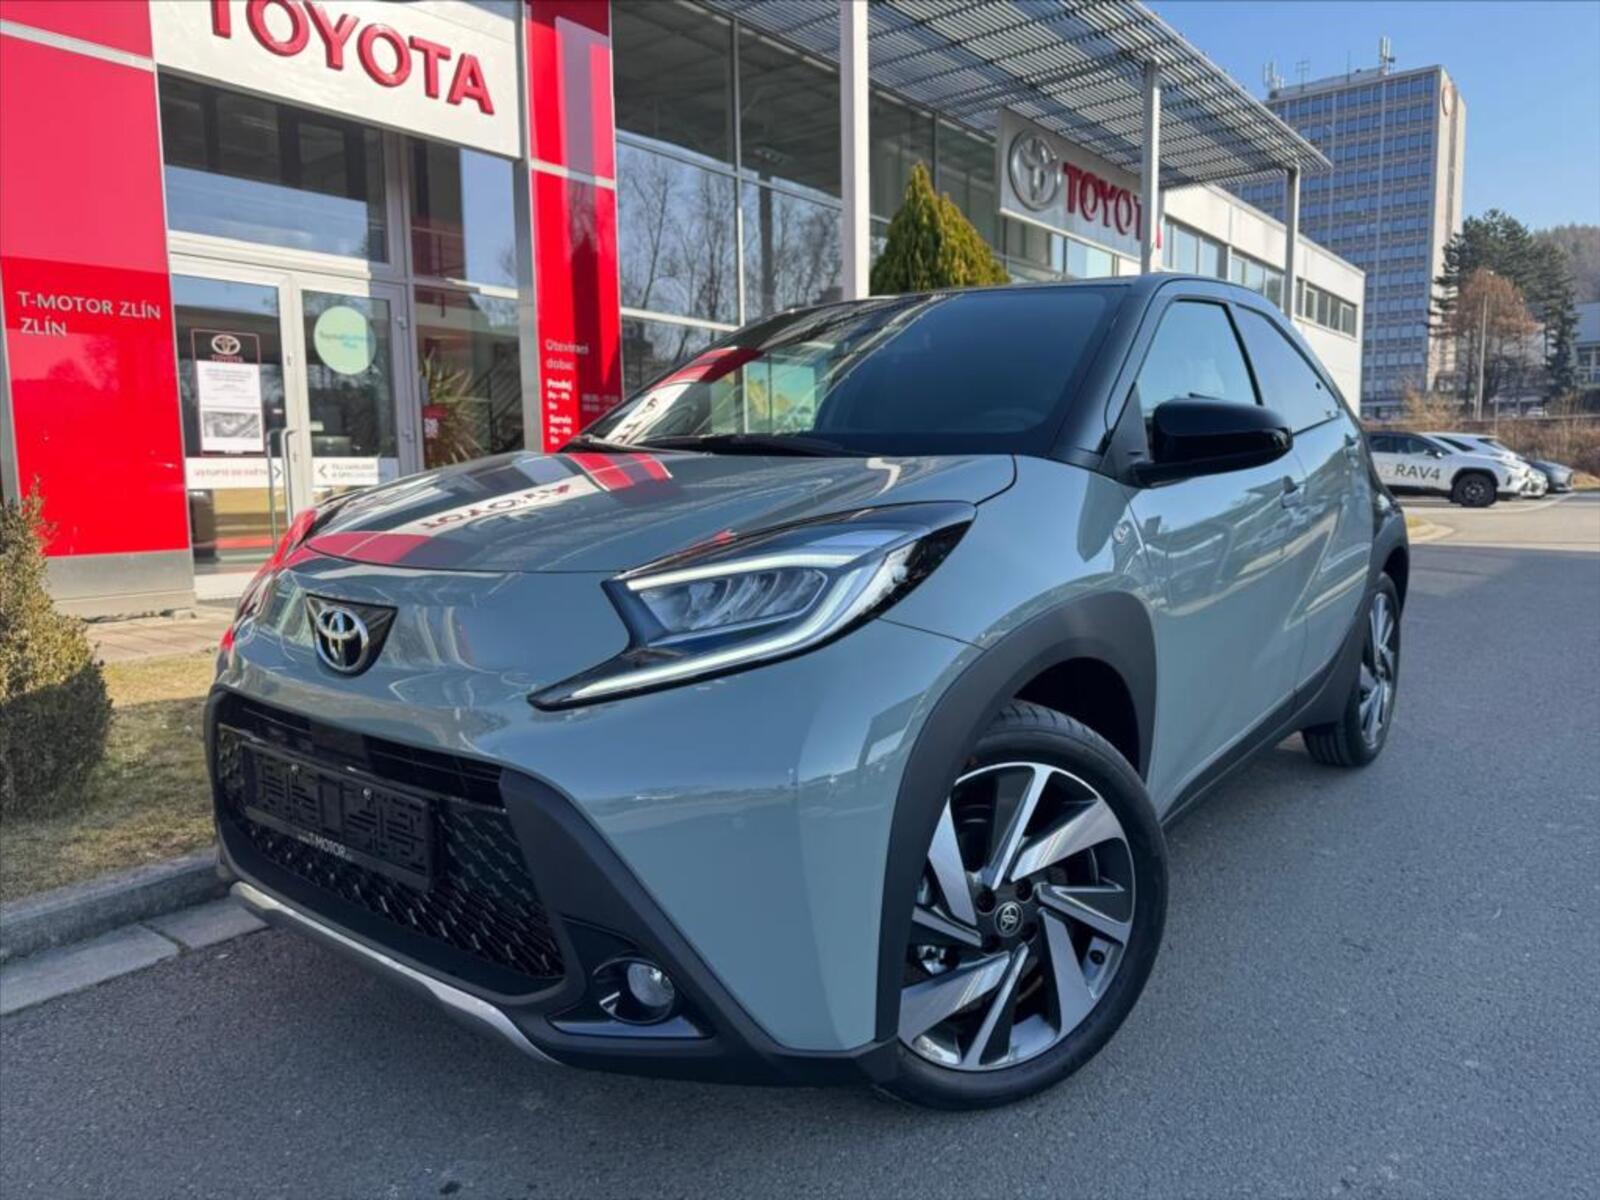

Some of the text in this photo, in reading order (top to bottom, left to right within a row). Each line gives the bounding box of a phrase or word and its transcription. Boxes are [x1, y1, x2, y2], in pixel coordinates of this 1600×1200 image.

[1062, 161, 1162, 249] TOYOT
[16, 291, 161, 320] T-MOTOR ZLÍN
[20, 316, 67, 337] ZLÍN
[1395, 463, 1440, 481] RAV4
